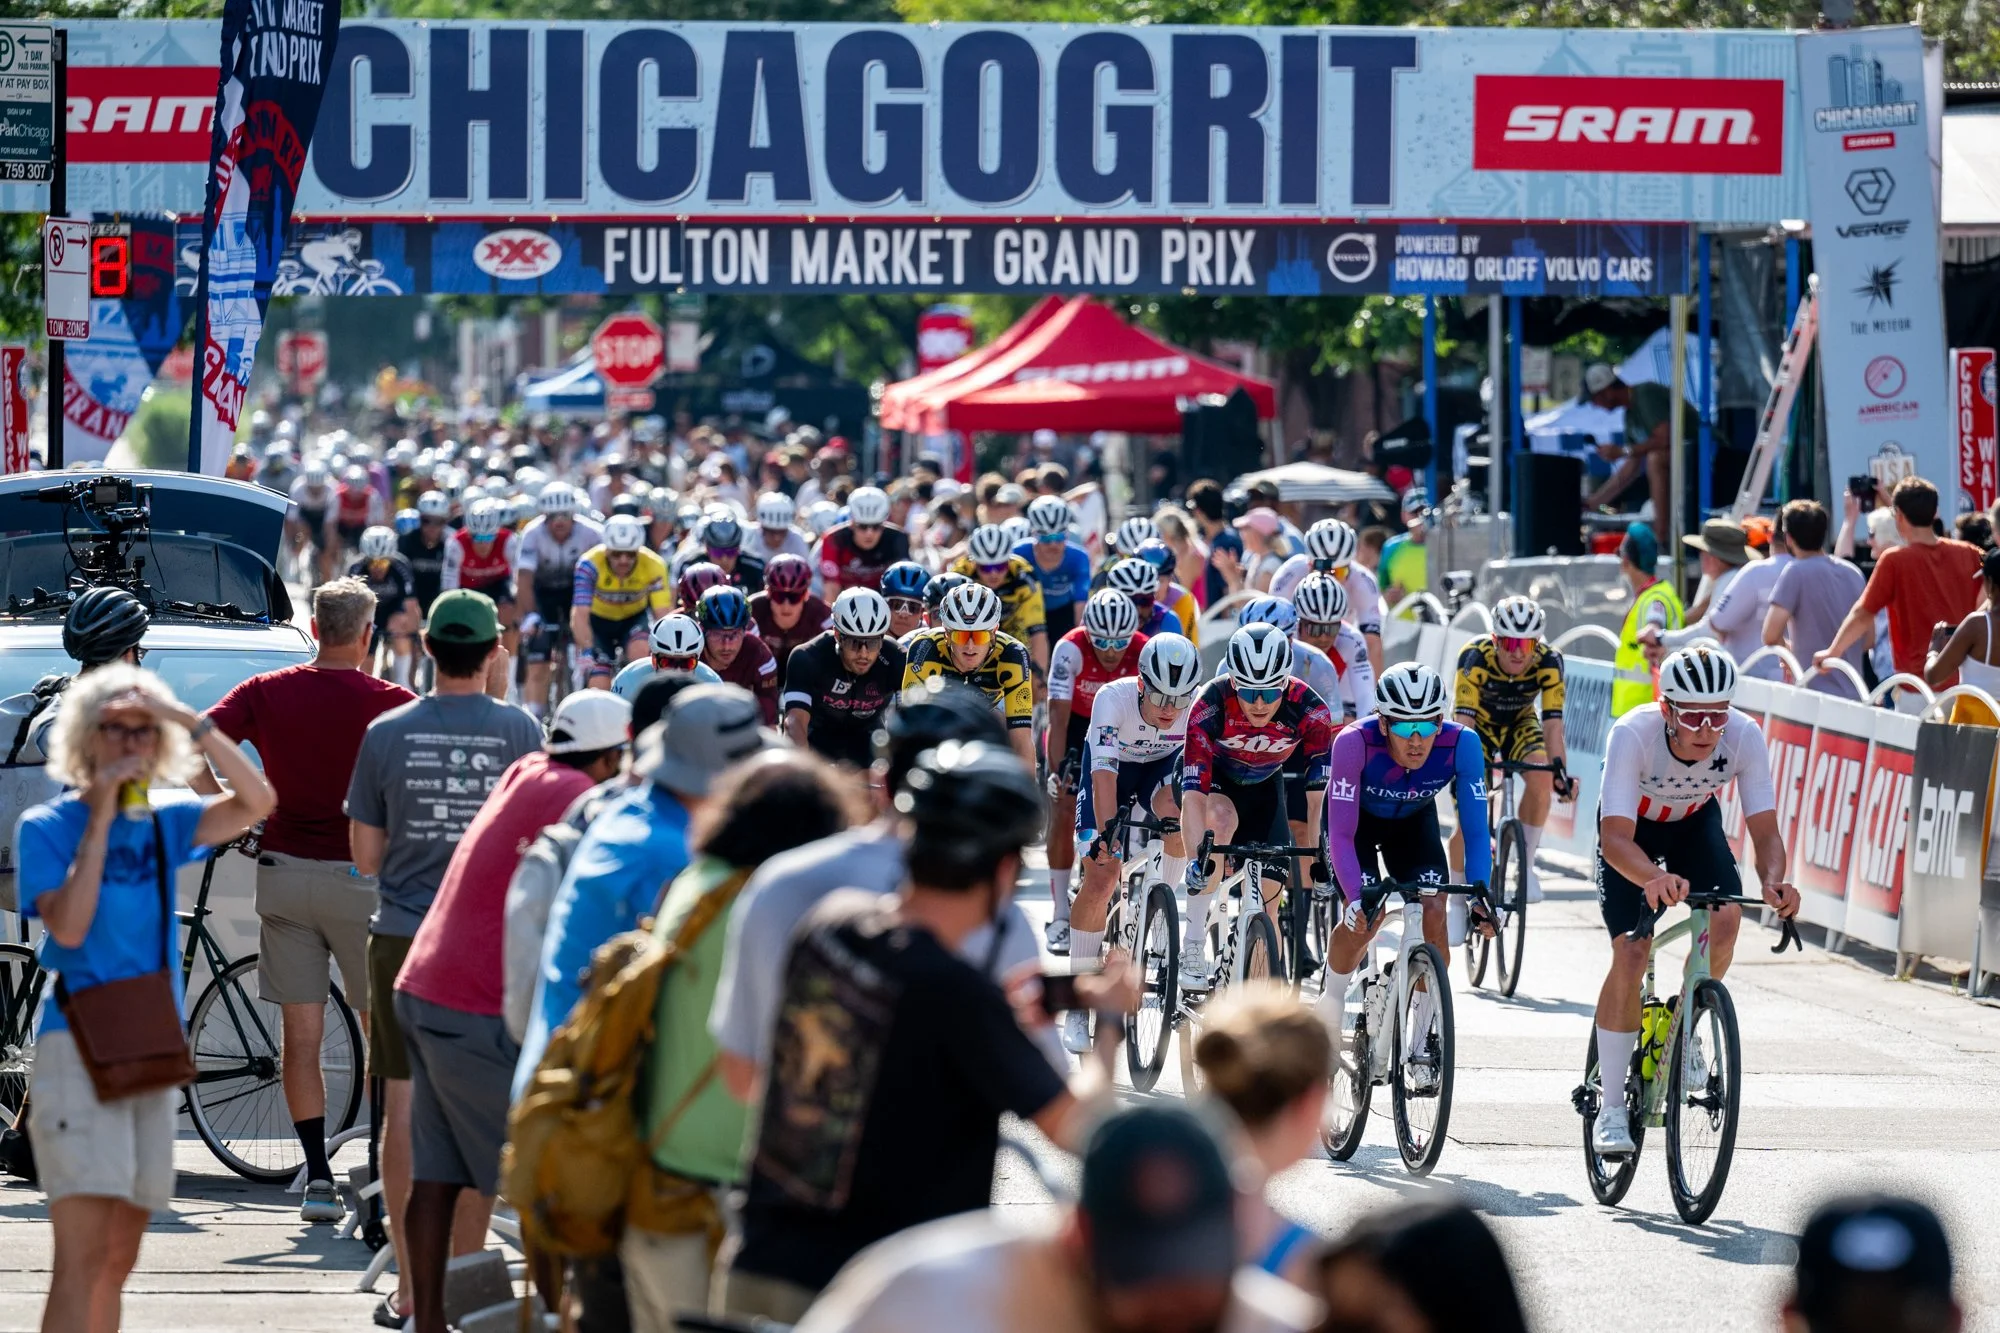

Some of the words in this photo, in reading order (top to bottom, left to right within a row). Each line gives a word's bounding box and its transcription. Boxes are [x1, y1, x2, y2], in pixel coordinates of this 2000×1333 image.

[282, 0, 324, 35] MARKET
[25, 51, 29, 60] 7
[31, 51, 43, 61] DAY
[289, 35, 322, 85] PRIX
[5, 78, 15, 88] AT
[17, 79, 31, 89] PAY
[33, 79, 49, 90] BOX
[0, 124, 49, 141] ParkChicago
[312, 24, 1420, 209] CHICAGOGRIT
[1504, 104, 1755, 144] SRAM
[1815, 102, 1918, 131] CHICAGOGRIT
[5, 164, 25, 178] 759
[27, 164, 46, 179] 307
[605, 228, 769, 285] FULTON
[791, 229, 972, 285] MARKET
[994, 229, 1139, 285] GRAND
[1161, 229, 1257, 286] PRIX
[1395, 235, 1457, 254] POWERED
[1462, 236, 1480, 253] BY
[1395, 257, 1469, 281] HOWARD
[1475, 258, 1539, 281] ORLOFF
[1546, 258, 1600, 281] VOLVO
[1606, 258, 1653, 281] CARS
[49, 321, 64, 335] TOW
[67, 321, 86, 336] ZONE
[599, 334, 662, 369] STOP
[4, 351, 14, 474] CROSS
[1858, 401, 1919, 415] AMERICAN
[1960, 356, 1975, 486] CROSS
[1977, 436, 1996, 512] WAL
[1804, 751, 1862, 874] CLIF
[1859, 766, 1913, 889] CLIF
